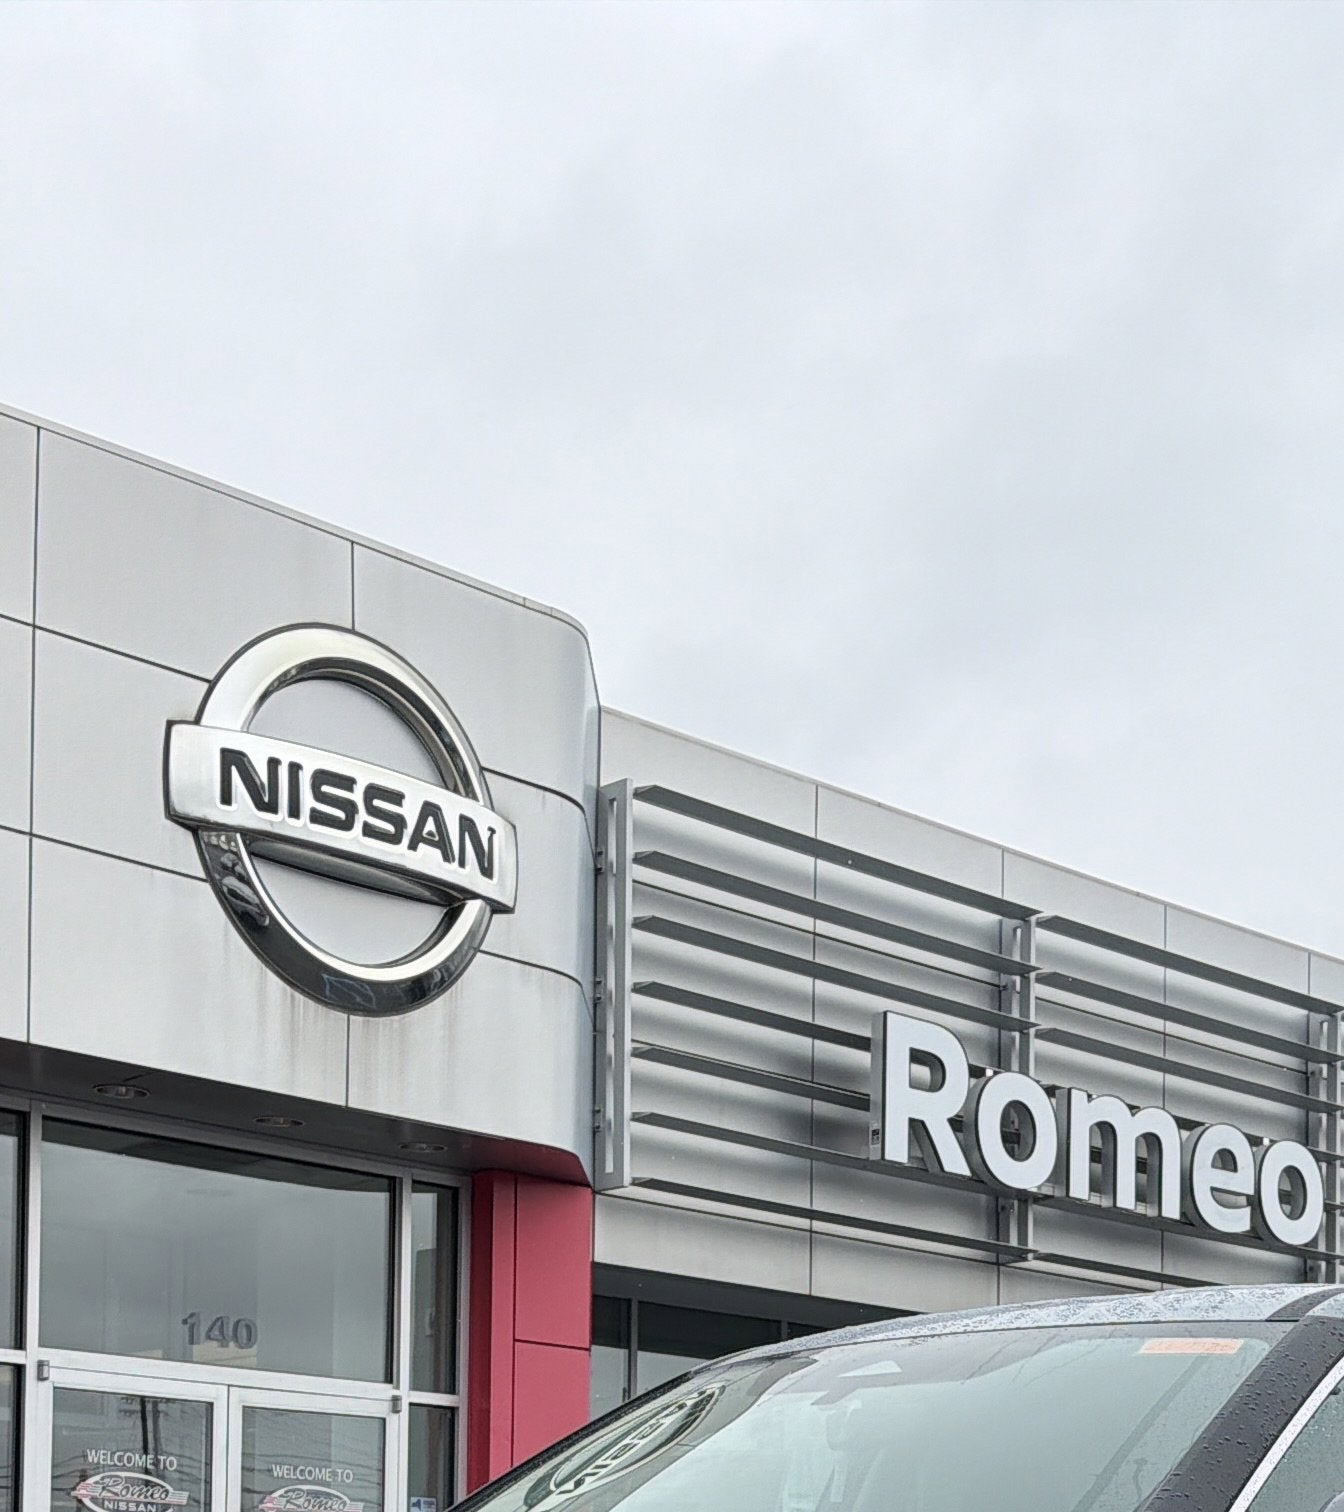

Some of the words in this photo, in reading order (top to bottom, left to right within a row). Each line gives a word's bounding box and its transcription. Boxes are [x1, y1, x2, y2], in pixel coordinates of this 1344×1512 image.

[219, 747, 496, 880] NISSAN
[874, 1010, 1324, 1246] Romeo
[181, 1311, 258, 1349] 140
[87, 1449, 154, 1468] WELCOME
[158, 1456, 177, 1470] TO
[272, 1464, 333, 1481] WELCOME
[336, 1469, 353, 1483] TO
[93, 1475, 170, 1500] Romeo
[279, 1488, 347, 1511] Romeo
[104, 1500, 157, 1512] NISSAN
